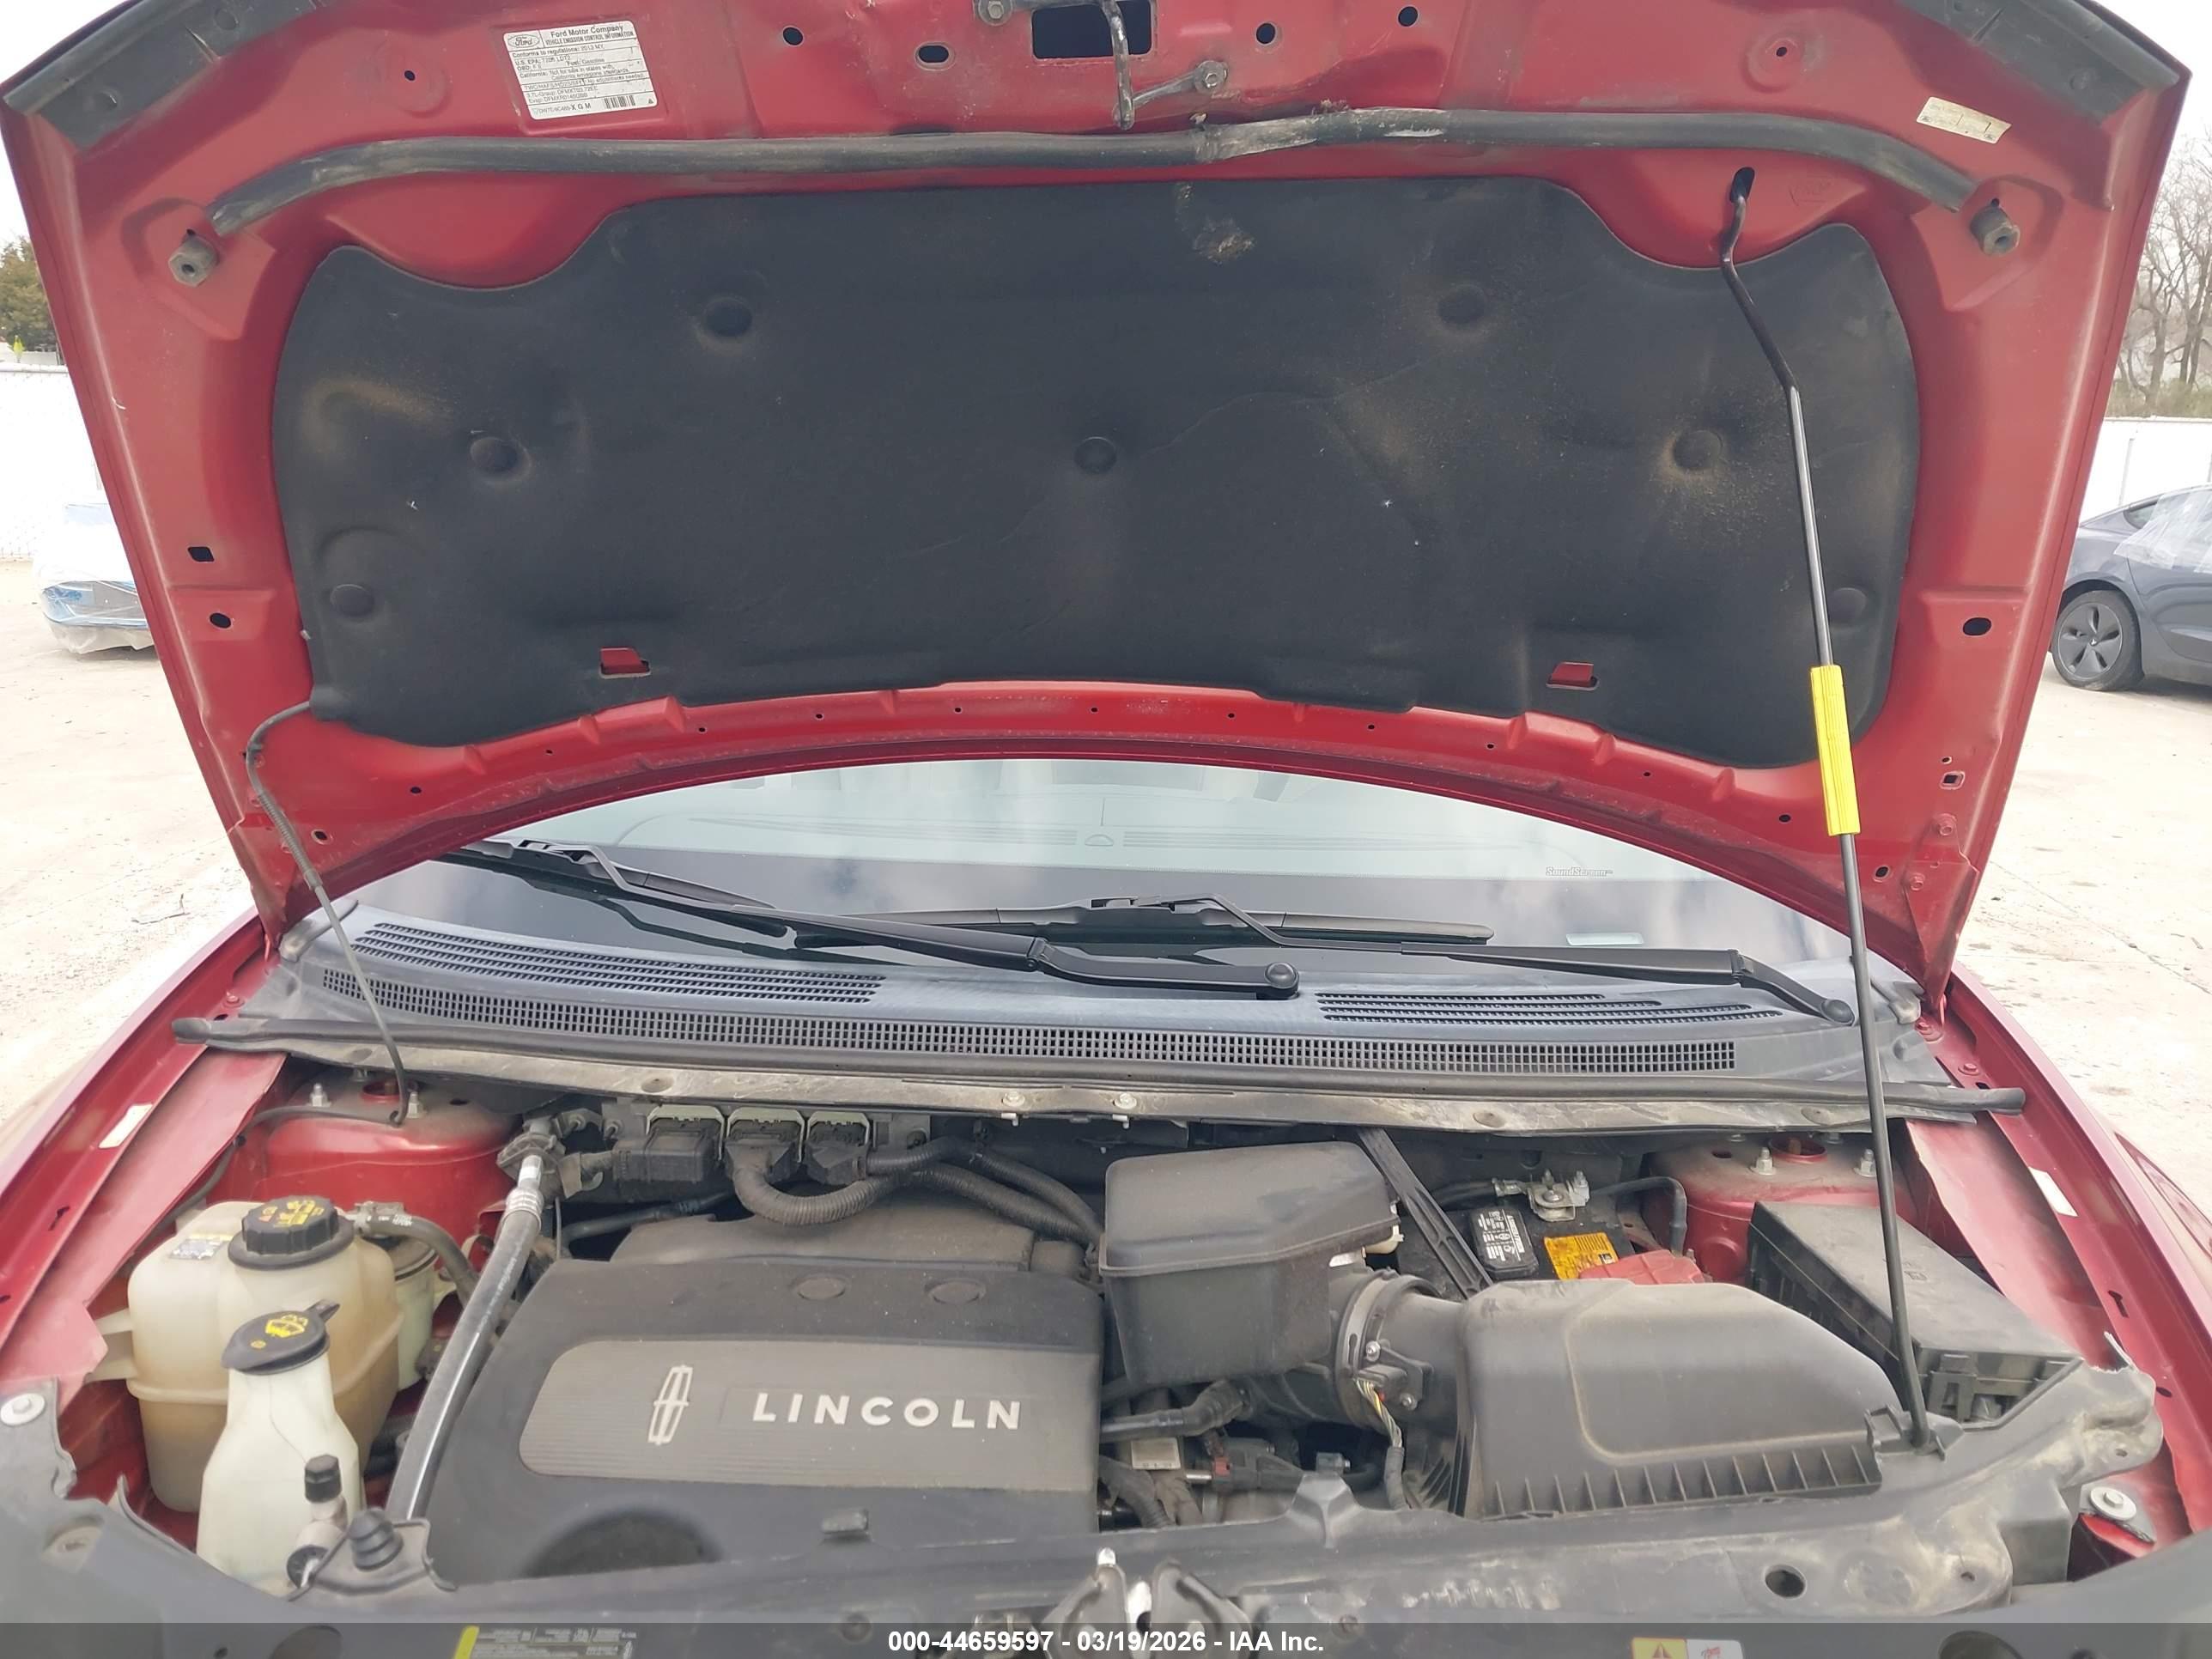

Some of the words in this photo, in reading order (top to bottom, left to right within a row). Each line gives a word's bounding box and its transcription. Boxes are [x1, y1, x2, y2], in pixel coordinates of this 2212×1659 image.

[590, 26, 623, 34] Company
[515, 36, 532, 46] Ford
[545, 37, 562, 46] VEHICLE
[563, 35, 584, 44] EMISSION
[584, 33, 605, 42] CONTROL
[605, 31, 635, 40] INFORMATION
[547, 46, 580, 56] regulations:
[752, 1392, 1020, 1430] LINCOLN
